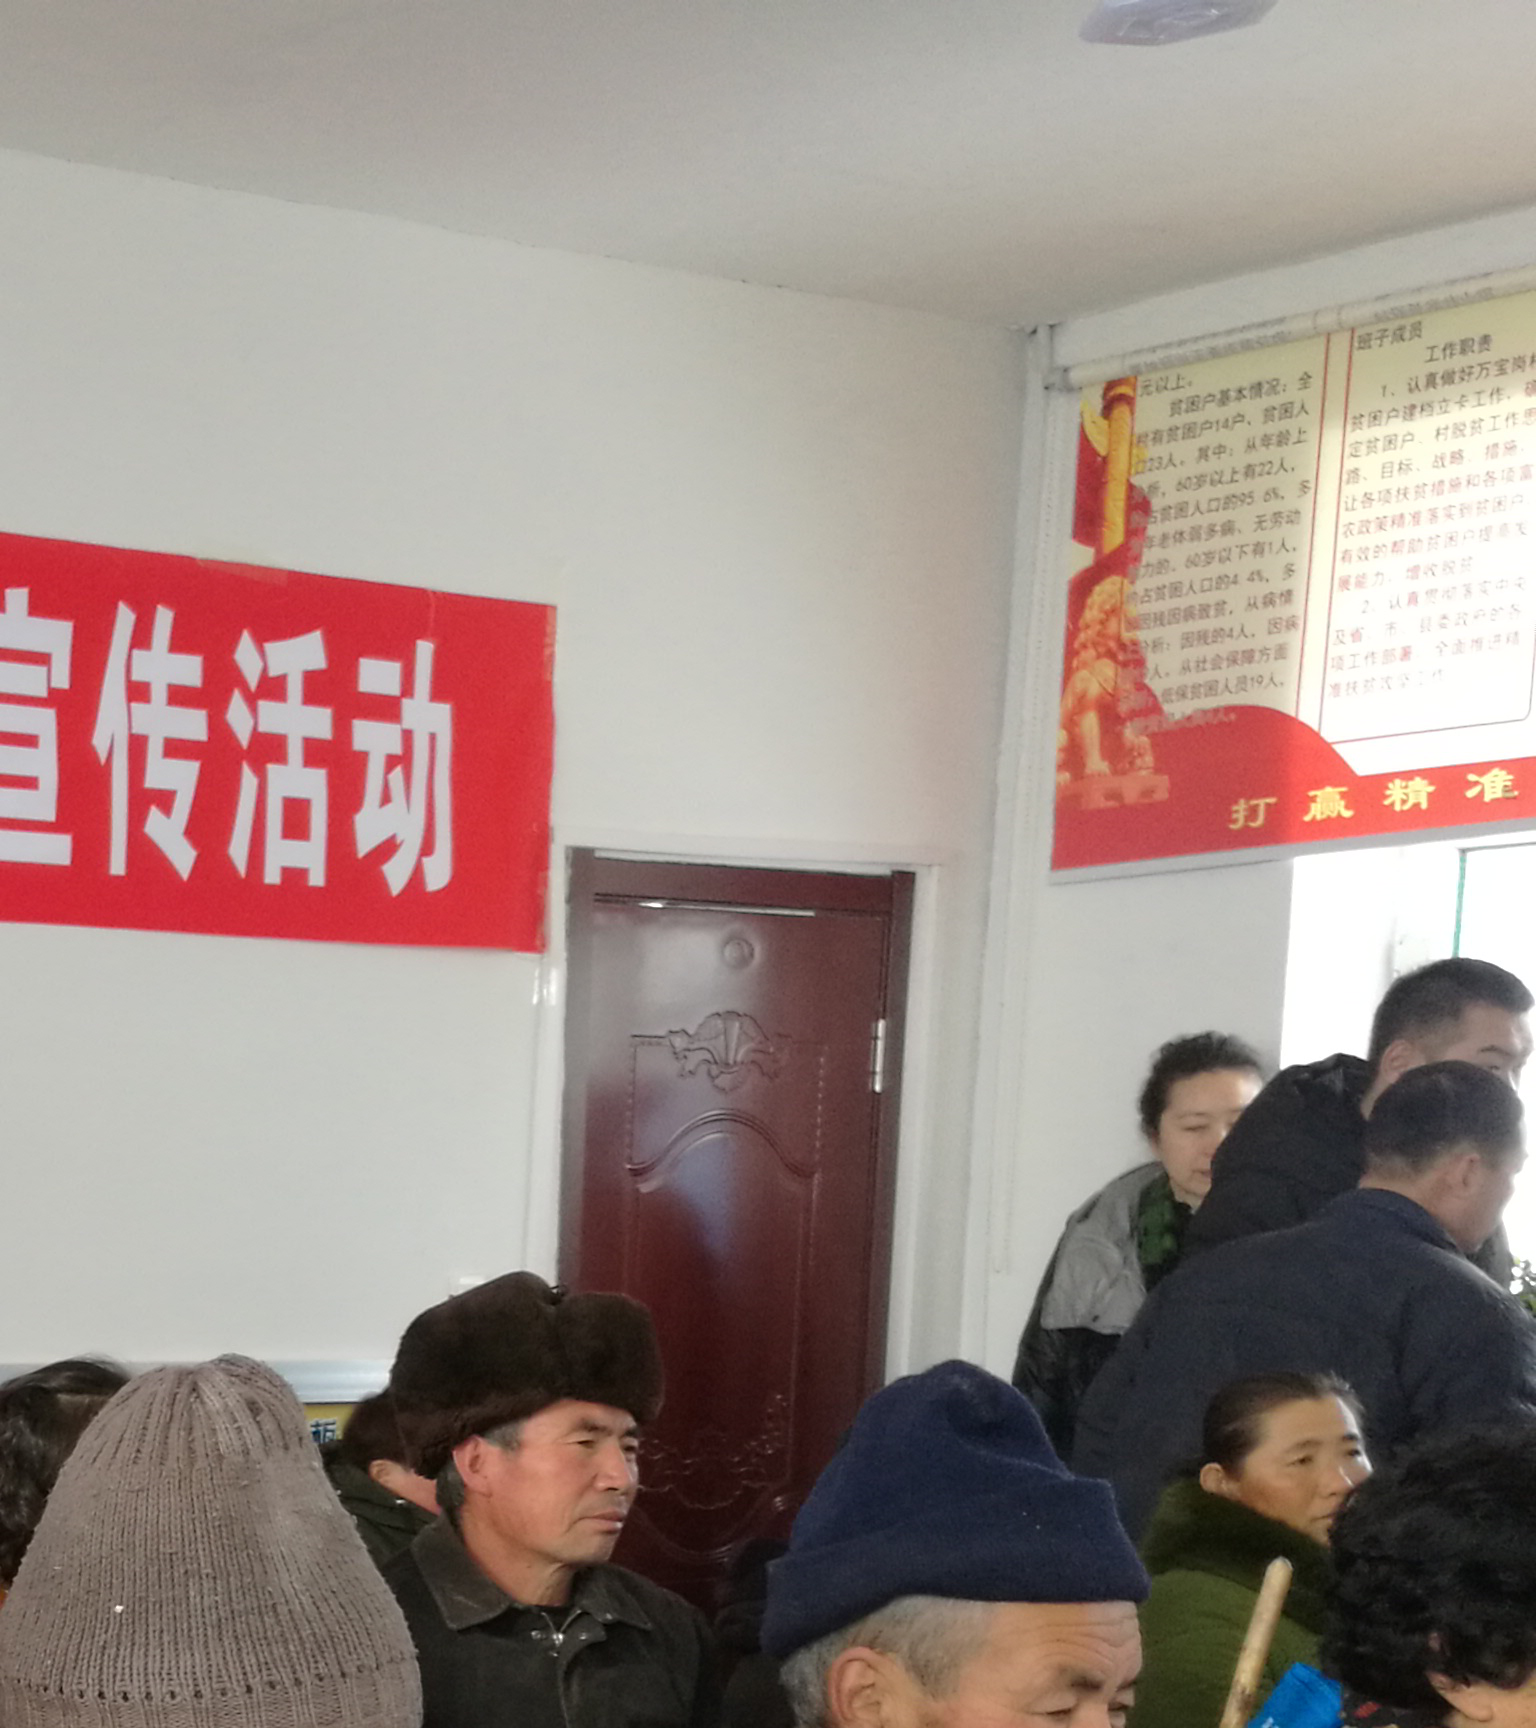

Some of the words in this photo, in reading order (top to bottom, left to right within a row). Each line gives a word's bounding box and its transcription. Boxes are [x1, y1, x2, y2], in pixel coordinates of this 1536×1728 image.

[1355, 320, 1423, 351] 班子成员
[1424, 333, 1493, 364] 工作职责
[1228, 767, 1519, 831] 打赢精准
